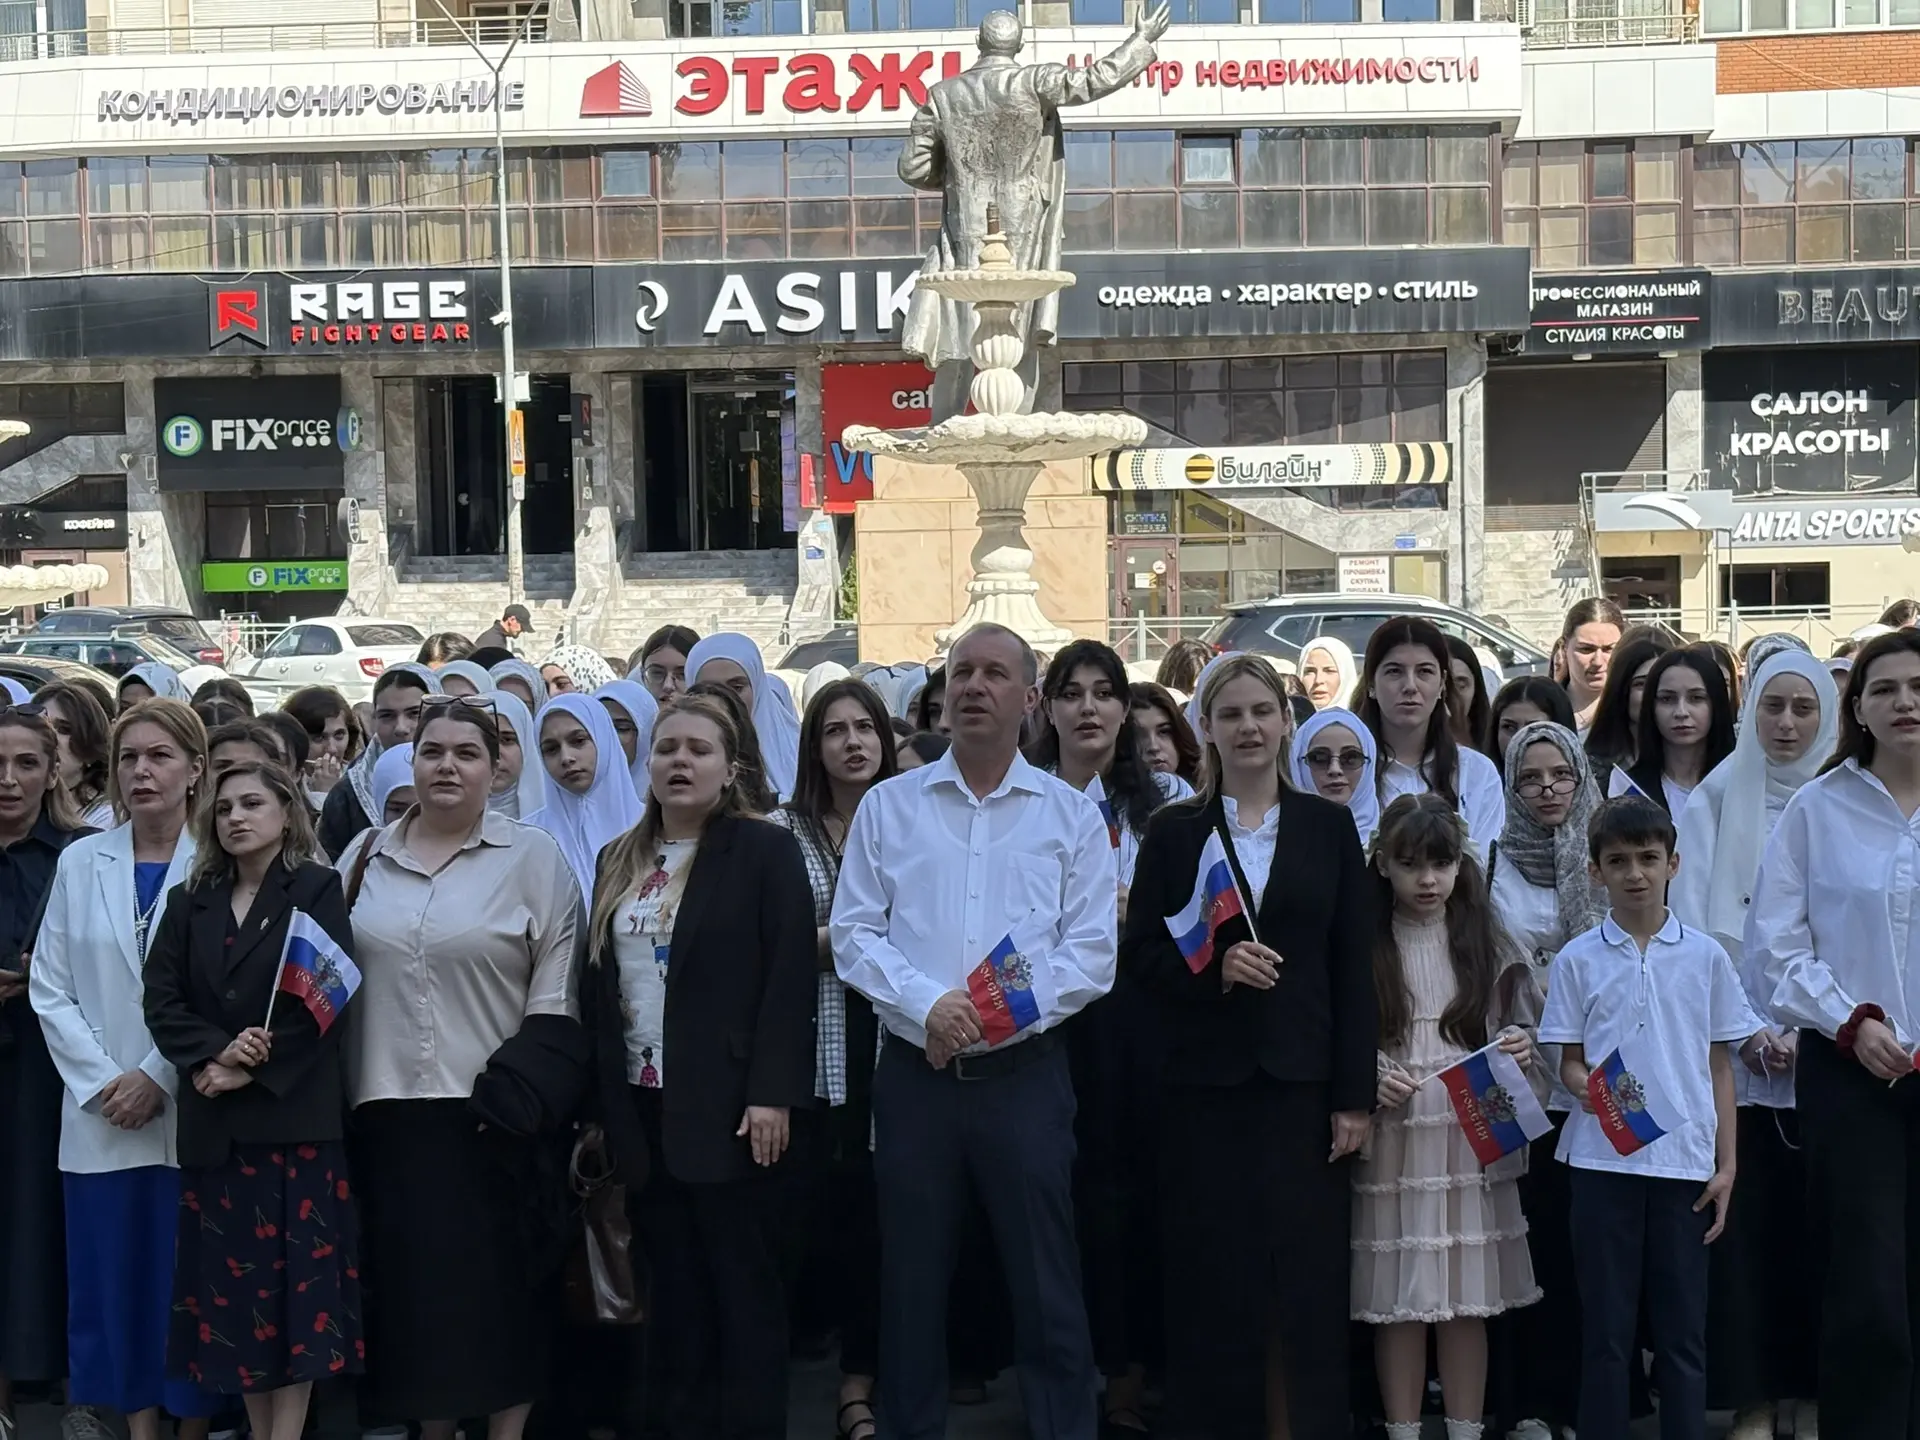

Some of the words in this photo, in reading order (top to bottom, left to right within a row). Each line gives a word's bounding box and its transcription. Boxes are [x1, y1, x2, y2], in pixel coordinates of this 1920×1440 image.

[1196, 56, 1479, 91] недвижимости
[98, 81, 525, 125] КОНДИЦИОНИРОВАНИЕ
[290, 281, 467, 321] RAGE
[1098, 284, 1212, 307] одежда
[1237, 281, 1372, 306] характер
[1392, 280, 1478, 301] стиль
[1576, 303, 1653, 318] МАГАЗИН
[291, 324, 383, 343] FIGHT
[391, 323, 471, 342] GEAR
[1545, 327, 1606, 343] СТУДИЯ
[1612, 325, 1685, 341] КРАСОТЫ
[892, 384, 934, 410] caf
[1751, 389, 1867, 416] САЛОН
[273, 419, 331, 441] price
[1730, 428, 1889, 456] КРАСОТЫ
[1732, 511, 1801, 541] ANTA
[1459, 1088, 1489, 1140] РОССИЯ
